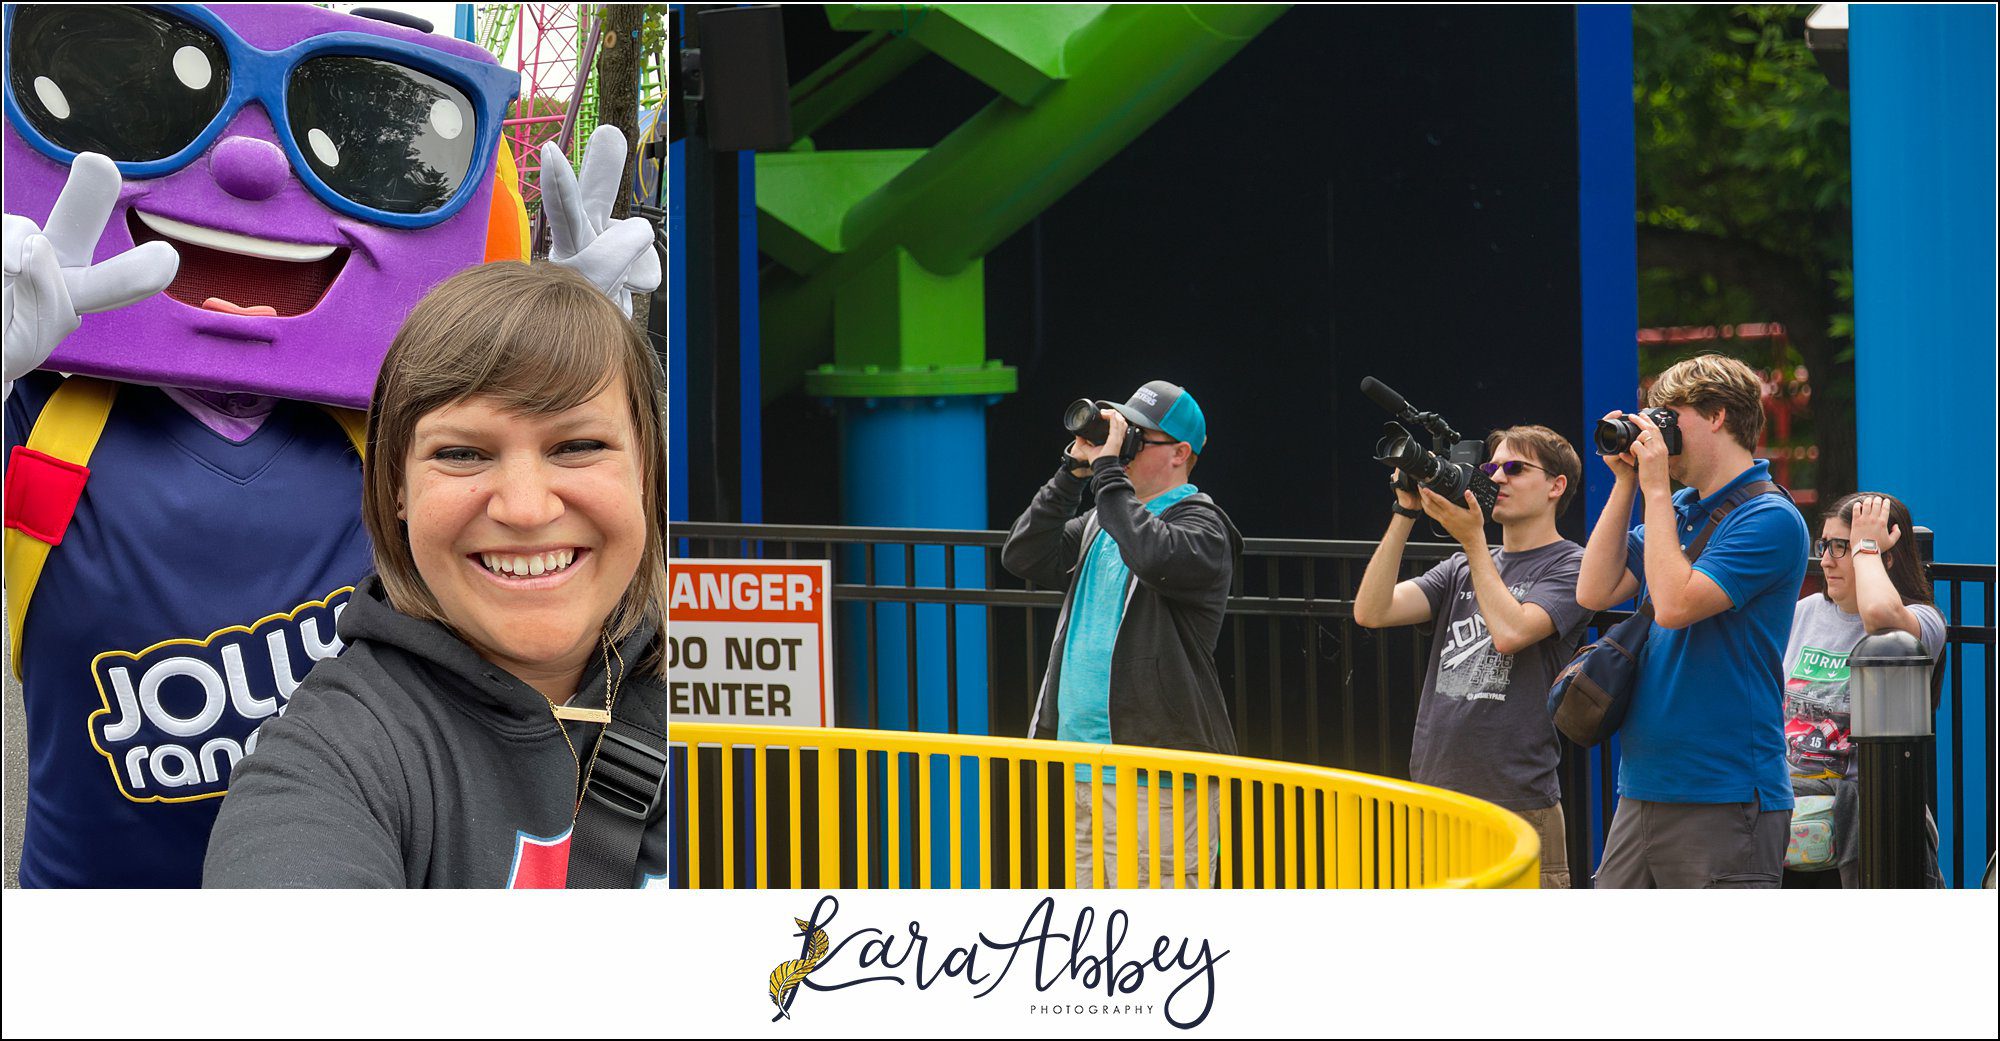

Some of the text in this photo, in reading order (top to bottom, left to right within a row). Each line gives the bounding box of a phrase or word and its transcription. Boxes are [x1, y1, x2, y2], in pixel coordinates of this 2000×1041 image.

[724, 637, 803, 672] NOT
[669, 682, 792, 717] ENTER
[126, 730, 259, 788] ran
[1809, 736, 1822, 749] 15
